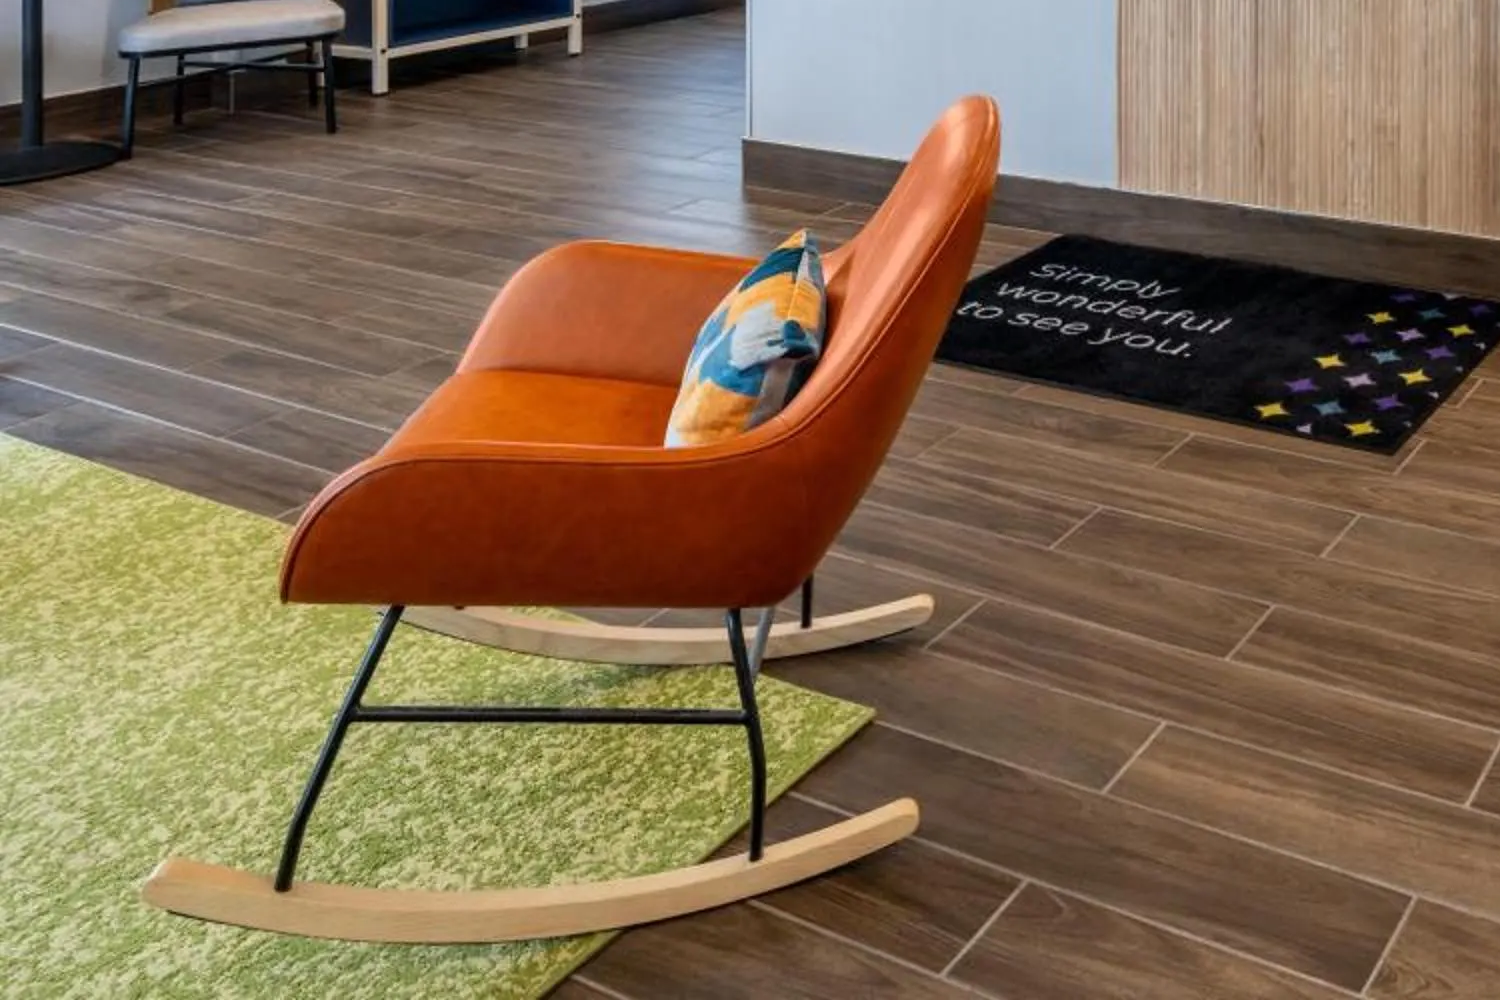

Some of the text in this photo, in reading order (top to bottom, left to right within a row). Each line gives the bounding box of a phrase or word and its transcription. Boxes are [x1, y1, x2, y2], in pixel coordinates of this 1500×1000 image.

[1029, 263, 1183, 299] Simply
[956, 301, 1192, 357] to see you.
[996, 282, 1234, 334] wonderful
